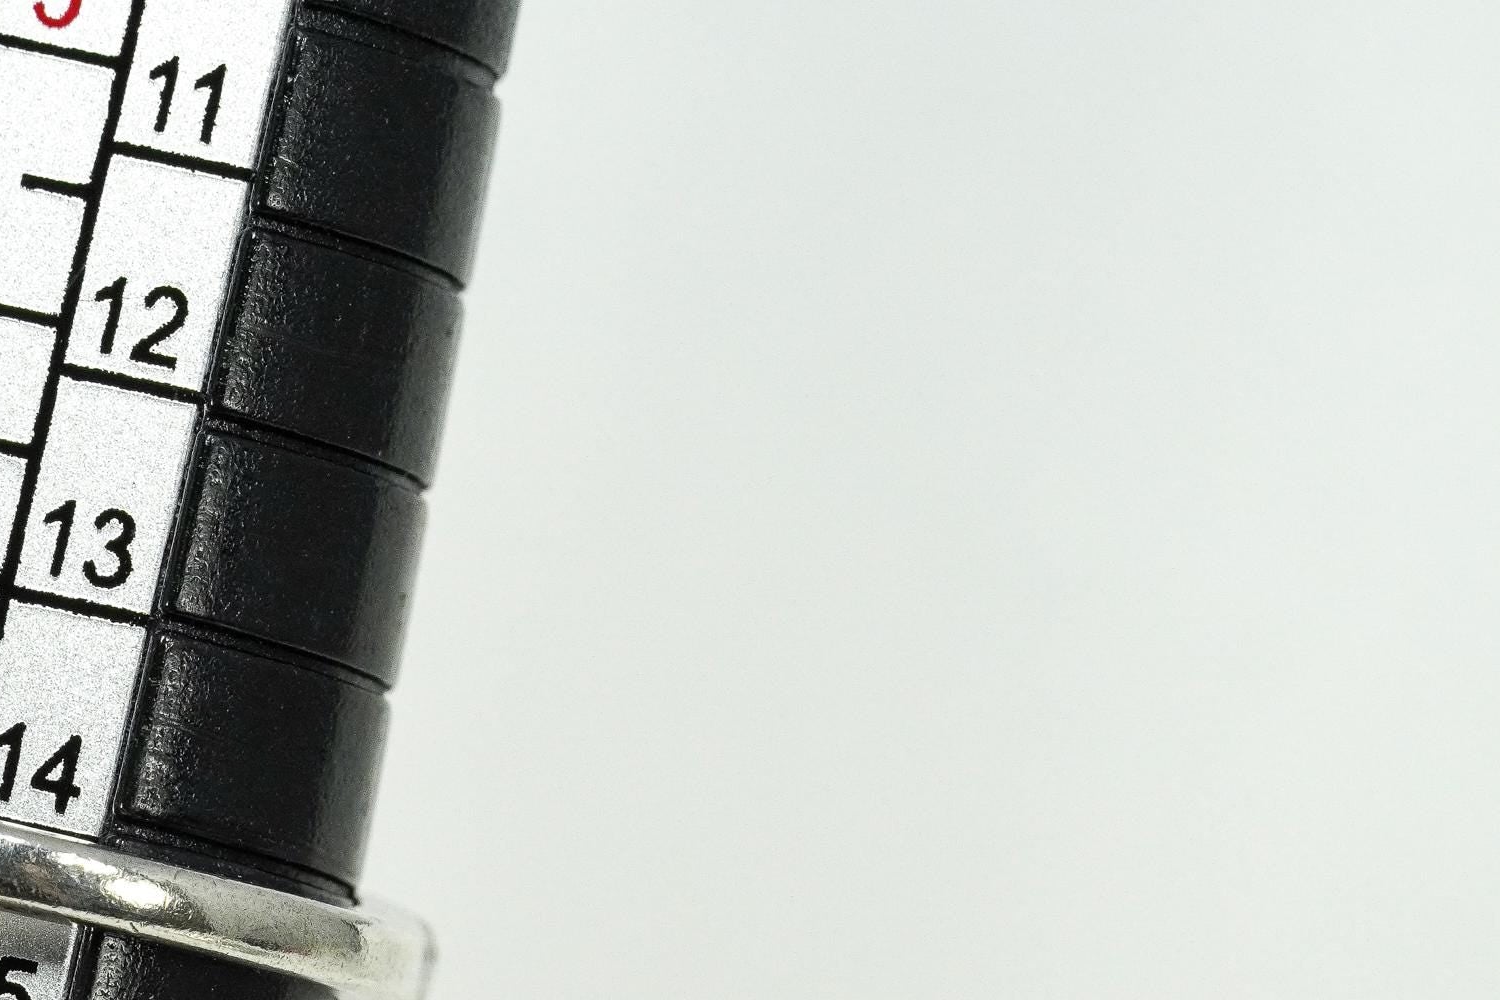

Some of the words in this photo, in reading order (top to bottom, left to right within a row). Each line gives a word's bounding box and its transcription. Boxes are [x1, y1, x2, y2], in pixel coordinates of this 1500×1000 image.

[150, 56, 226, 144] 11
[95, 277, 188, 370] 12
[43, 500, 136, 589] 13
